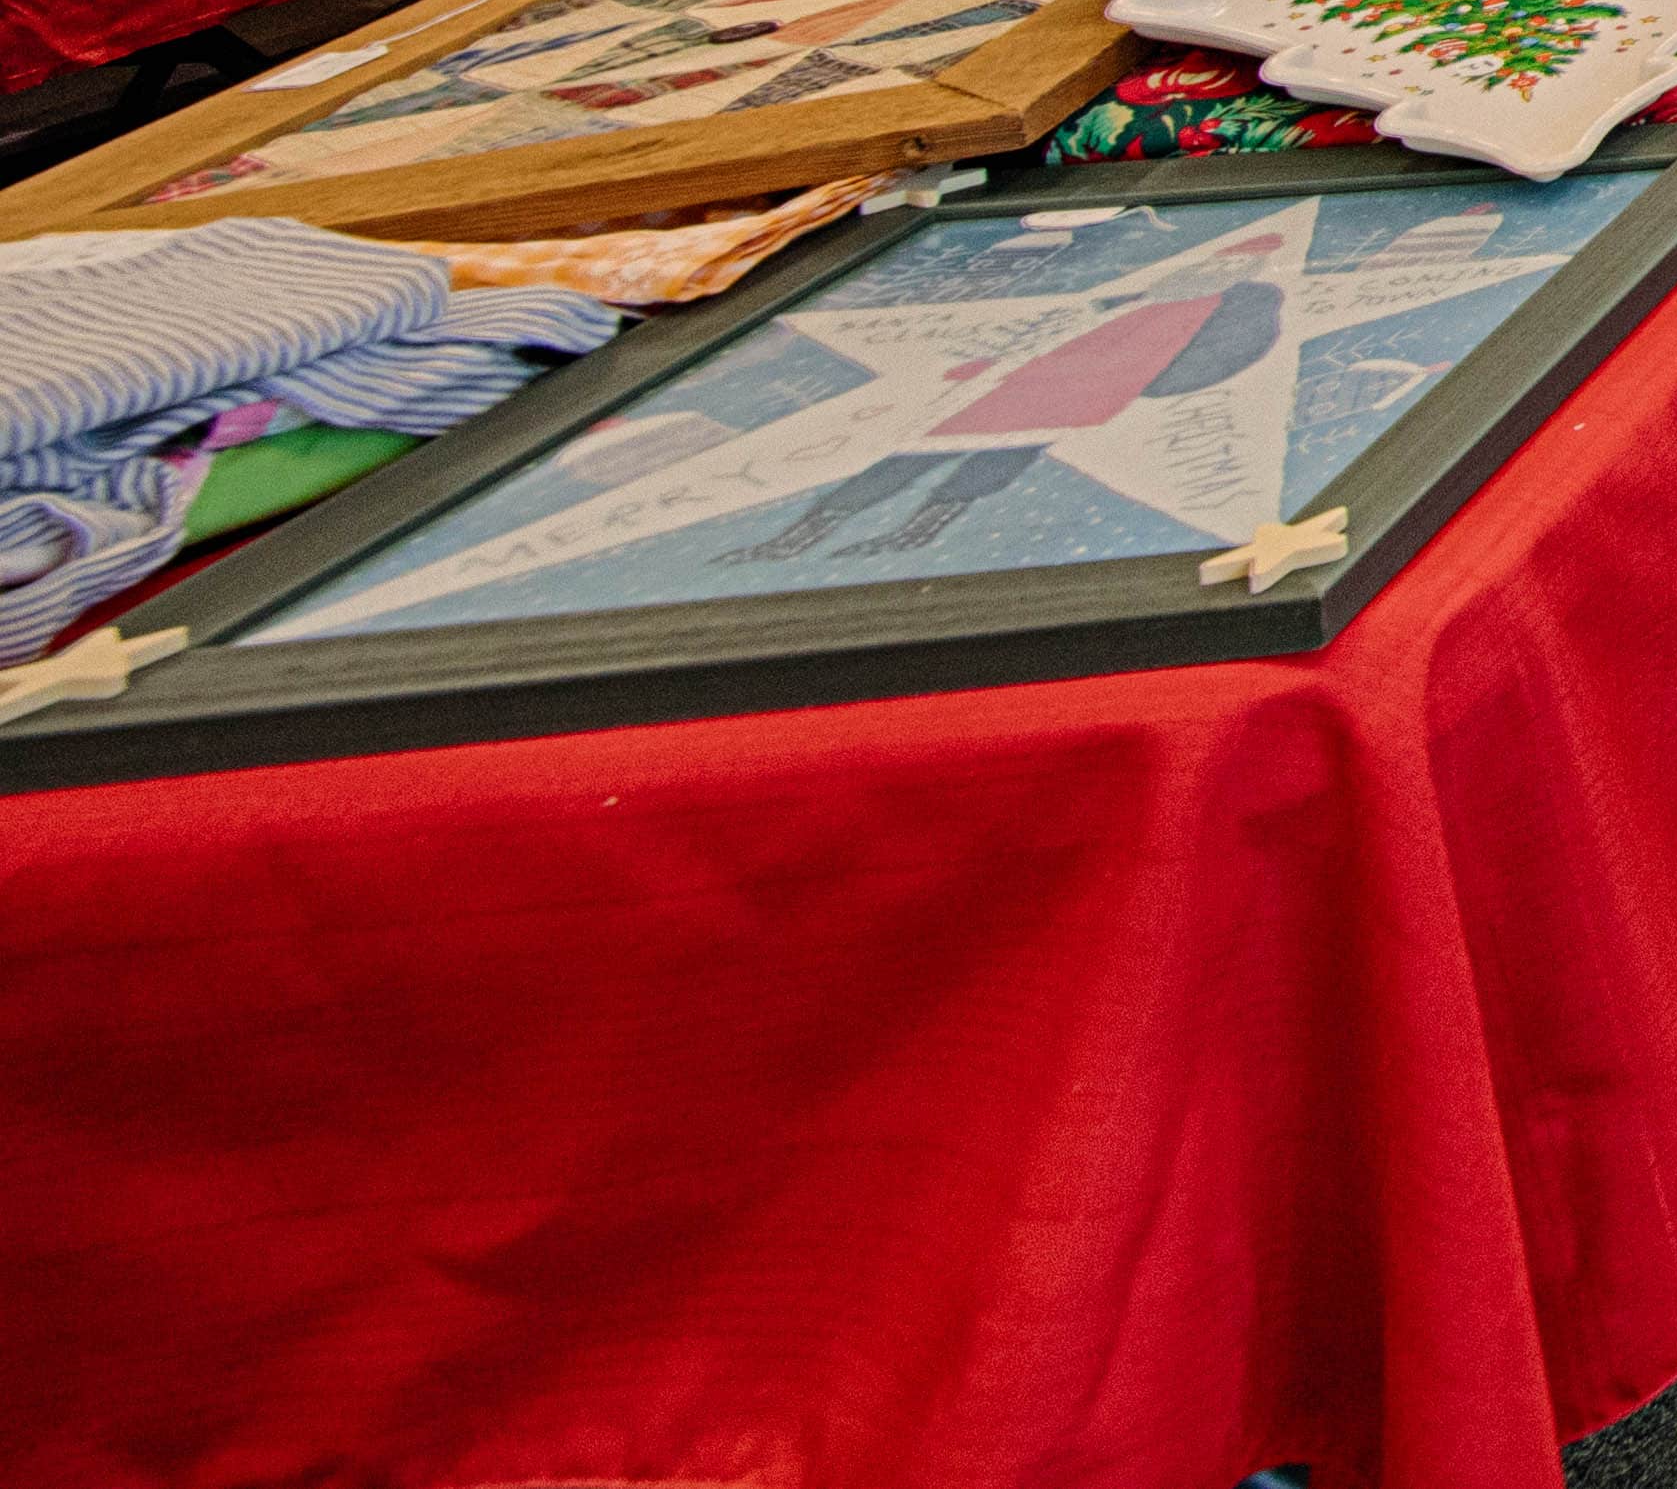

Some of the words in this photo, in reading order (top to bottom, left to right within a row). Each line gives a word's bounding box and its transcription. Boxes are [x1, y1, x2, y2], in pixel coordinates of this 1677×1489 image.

[1345, 284, 1450, 311] TOWN
[1357, 262, 1522, 291] COMING
[1143, 388, 1262, 512] CHRISTMAS
[458, 460, 768, 573] MERRY
